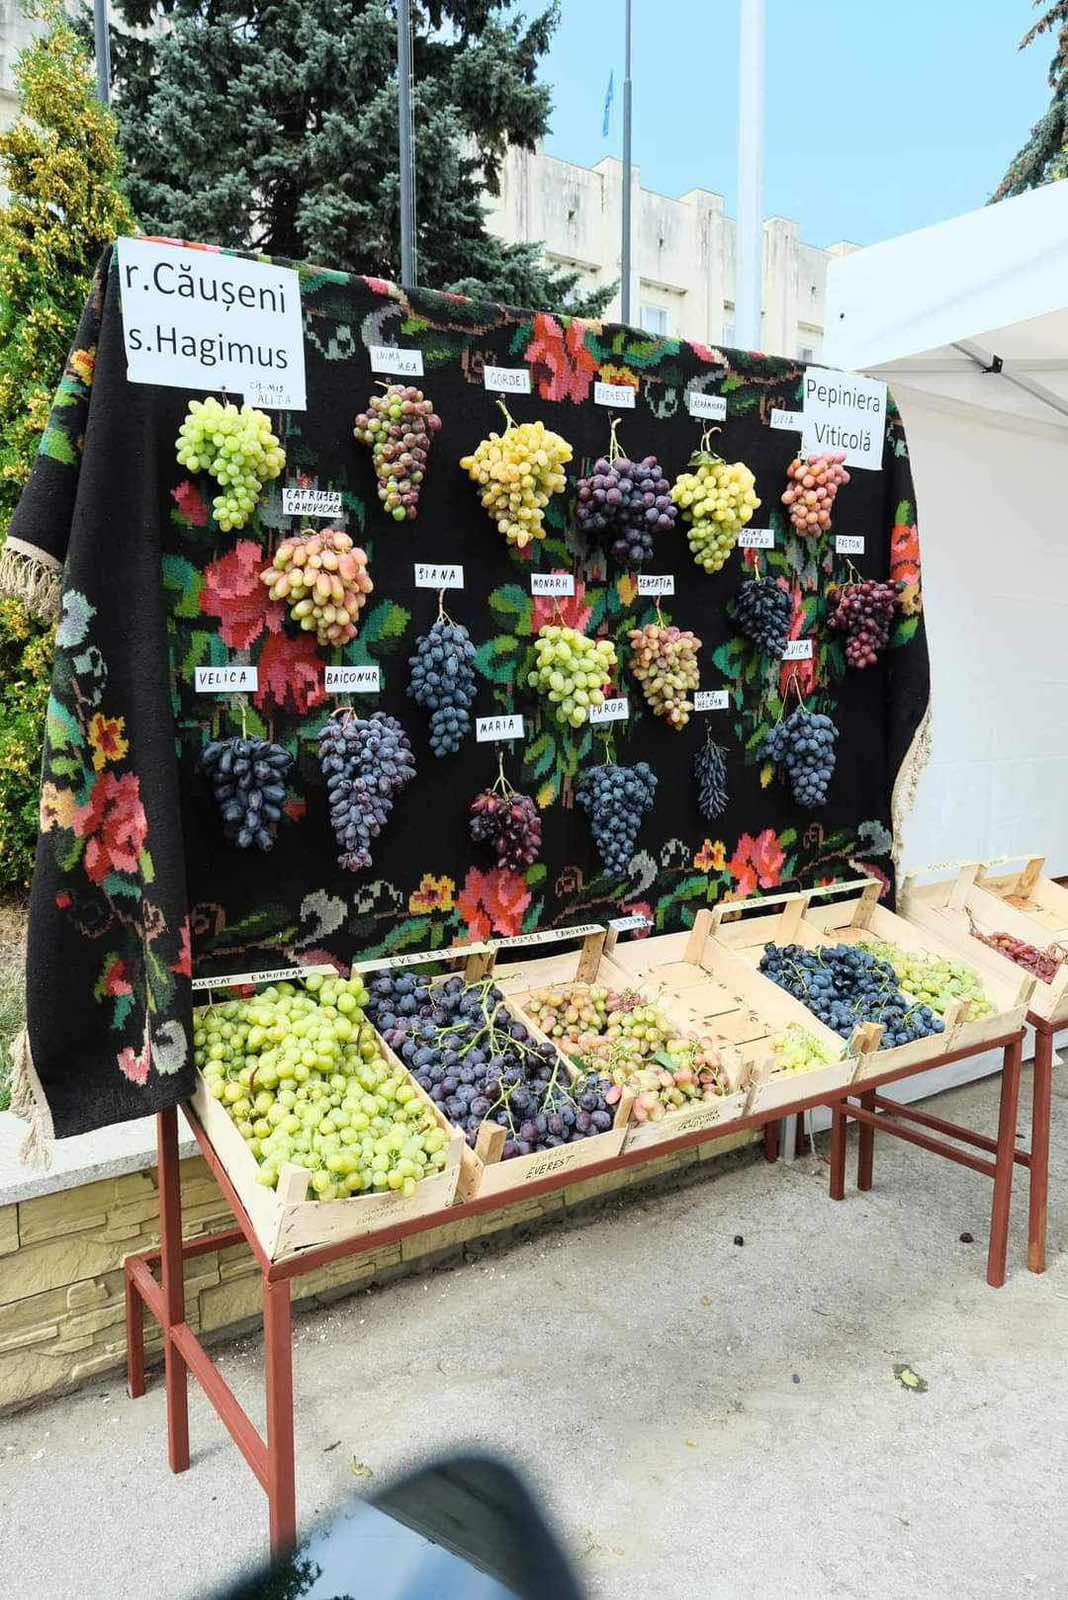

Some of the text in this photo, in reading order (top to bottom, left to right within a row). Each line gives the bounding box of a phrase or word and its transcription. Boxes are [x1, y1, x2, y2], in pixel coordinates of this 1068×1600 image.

[128, 325, 288, 369] s.Hagimus
[807, 379, 880, 412] Pepiniera
[814, 421, 871, 452] Viticolă
[326, 669, 378, 685] BAICONUR
[480, 719, 515, 734] MARIA
[525, 1154, 575, 1179] EVEREST
